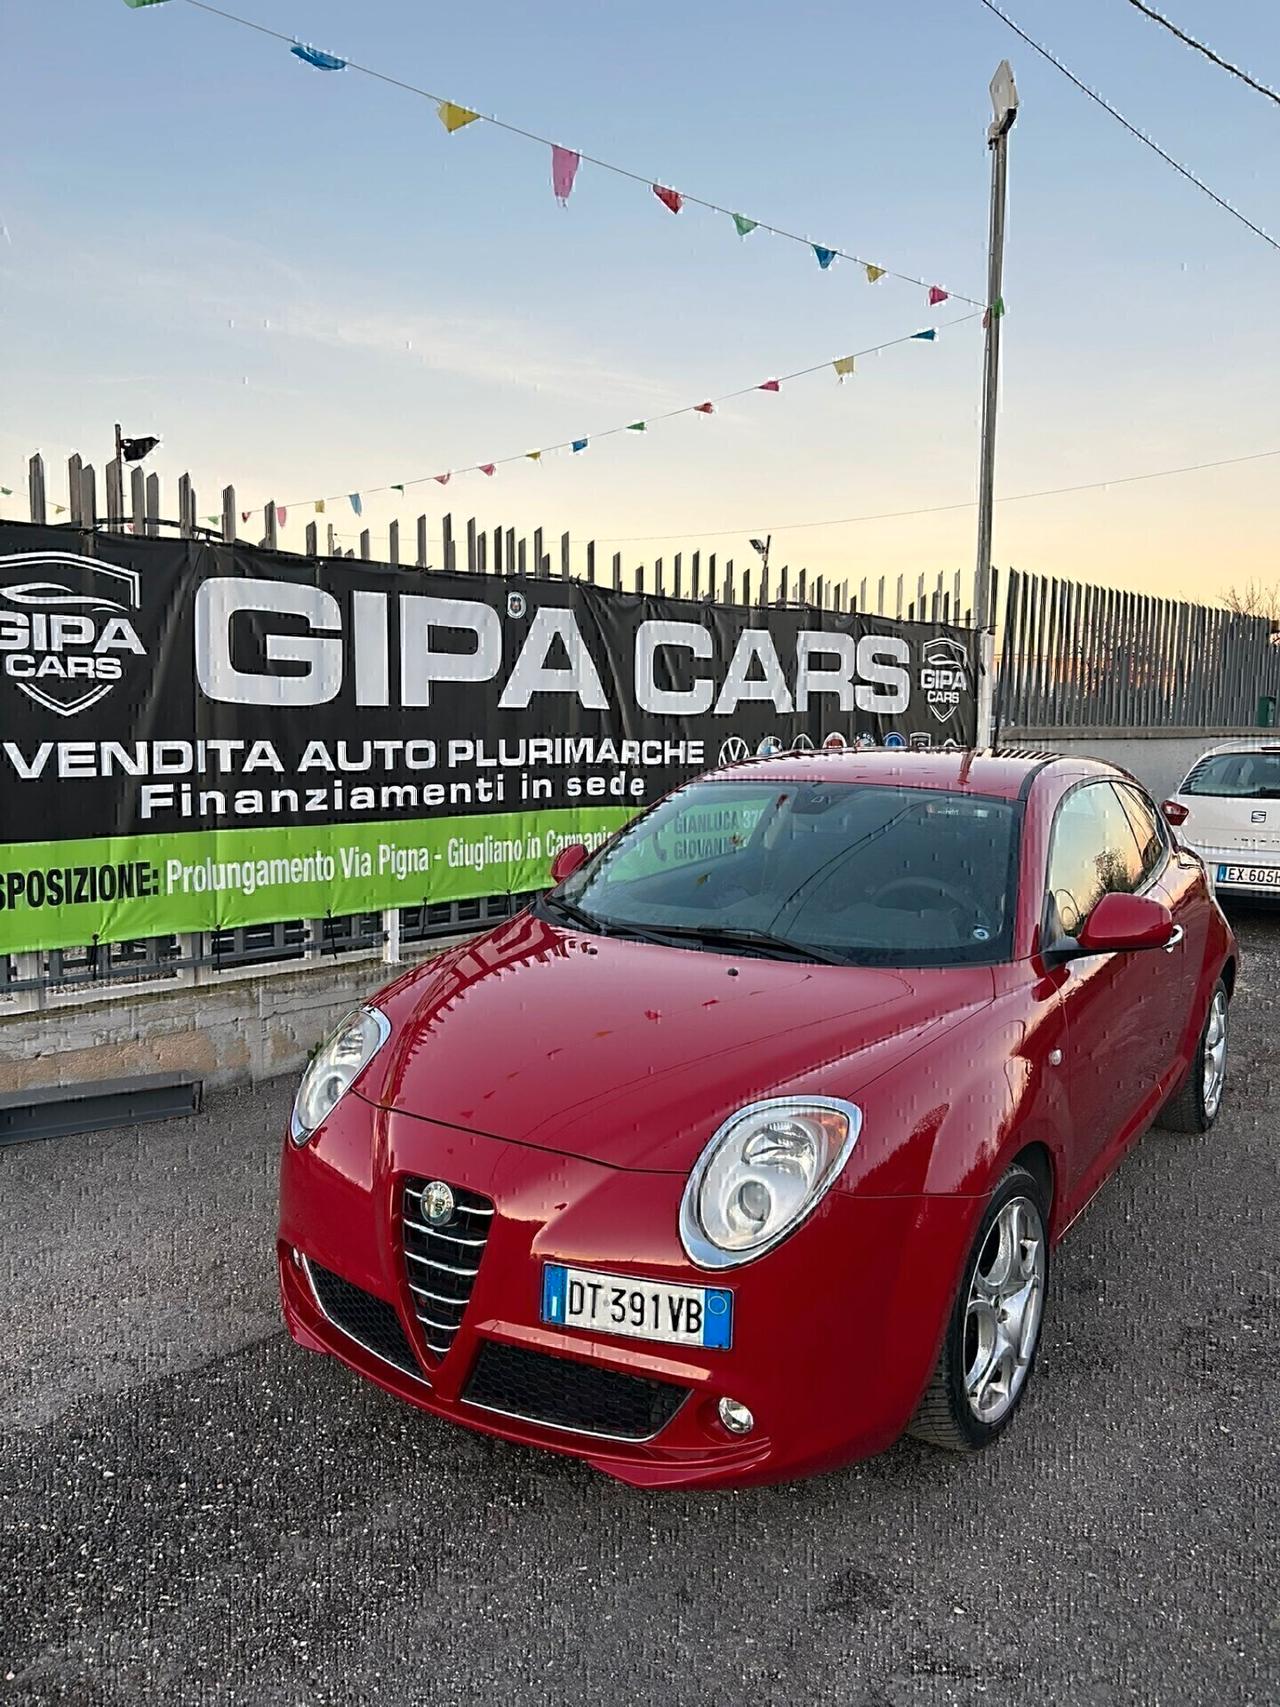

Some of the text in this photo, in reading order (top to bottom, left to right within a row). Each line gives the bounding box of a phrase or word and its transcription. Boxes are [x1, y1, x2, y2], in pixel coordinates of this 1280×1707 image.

[0, 610, 147, 655] GIPA
[195, 576, 910, 715] GIPA CARS
[5, 654, 122, 679] CARS
[921, 669, 967, 690] GIPA
[927, 690, 960, 703] CARS
[3, 738, 705, 778] VENDITA AUTO PLURIMARCHE
[140, 771, 646, 819] Finanziamenti in sede
[674, 811, 739, 834] GIANLUCA
[166, 850, 336, 895] Prolungamento
[340, 847, 372, 879] Via
[379, 843, 430, 881] Pigna
[447, 834, 523, 873] Giugliano
[526, 832, 542, 860] in
[1228, 868, 1245, 881] EX
[568, 1280, 703, 1334] DT 391VB
